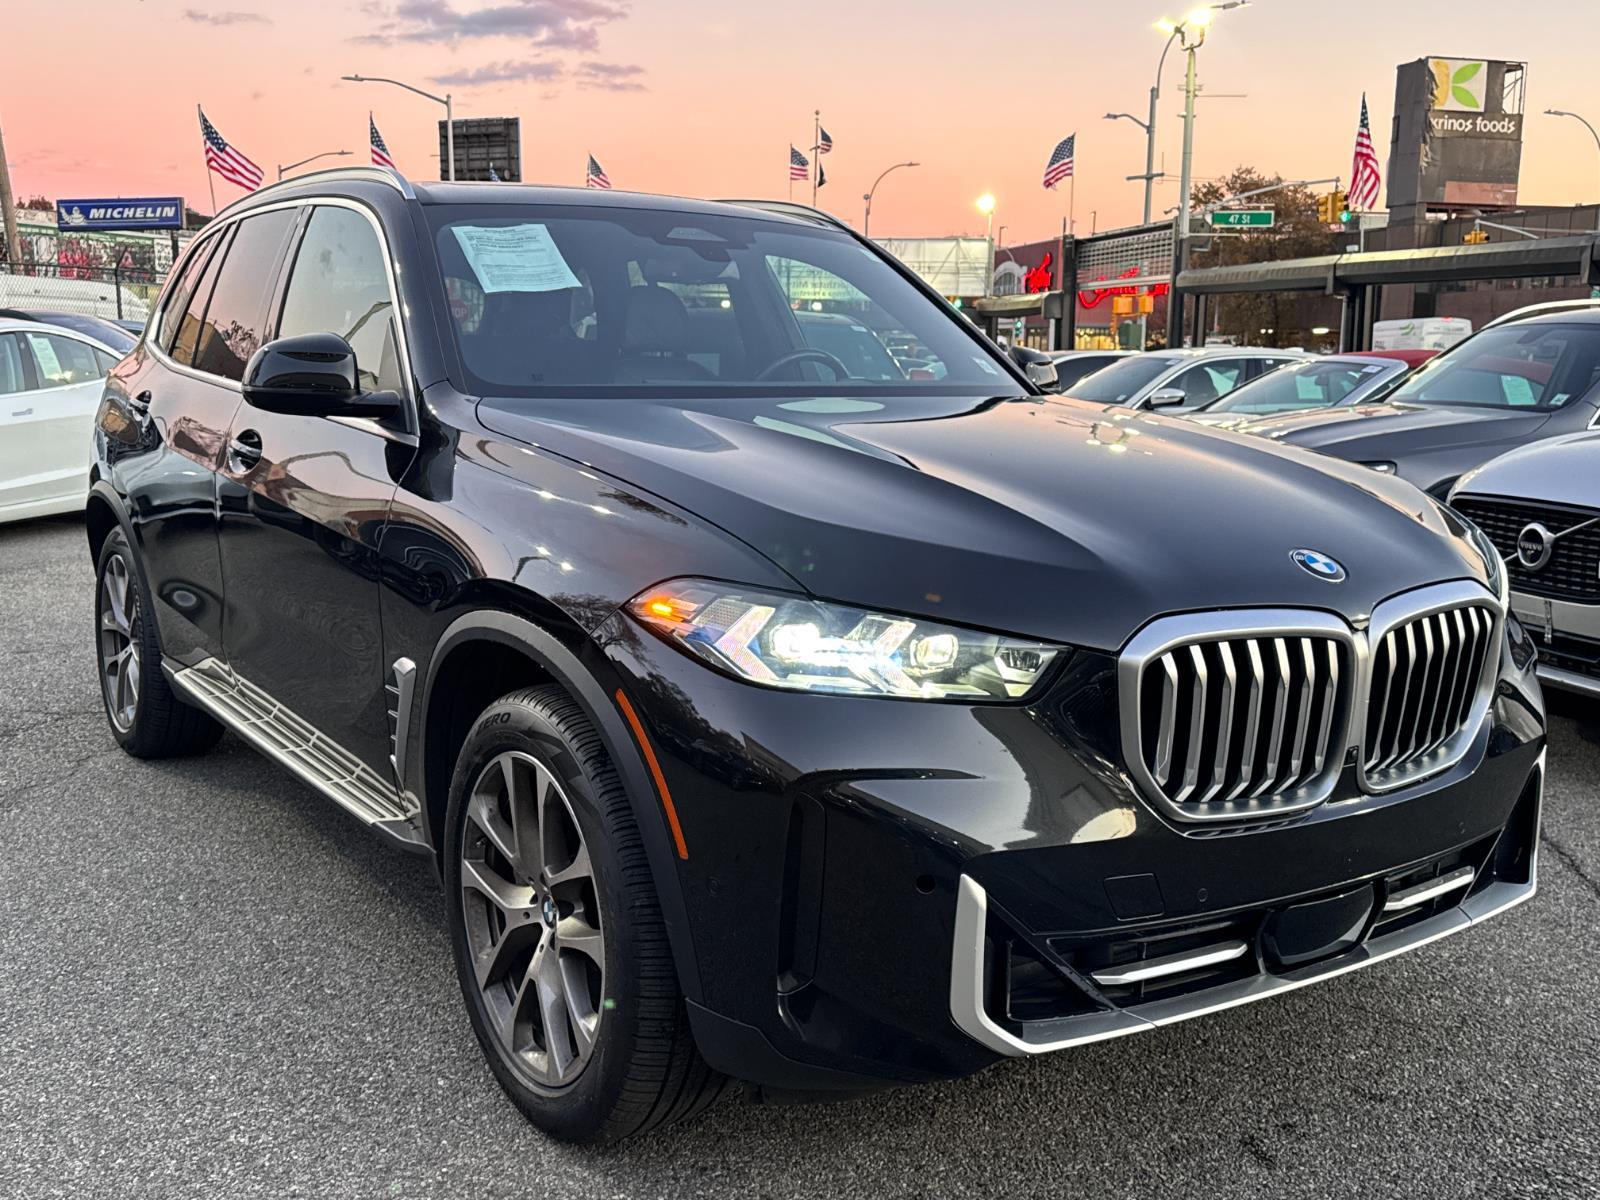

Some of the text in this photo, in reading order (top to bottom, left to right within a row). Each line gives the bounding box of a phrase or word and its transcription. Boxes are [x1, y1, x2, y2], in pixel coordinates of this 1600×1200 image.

[1475, 116, 1515, 134] foods
[89, 206, 176, 219] MICHELIN
[1228, 214, 1250, 224] 47 St
[1519, 542, 1543, 551] VOLVO
